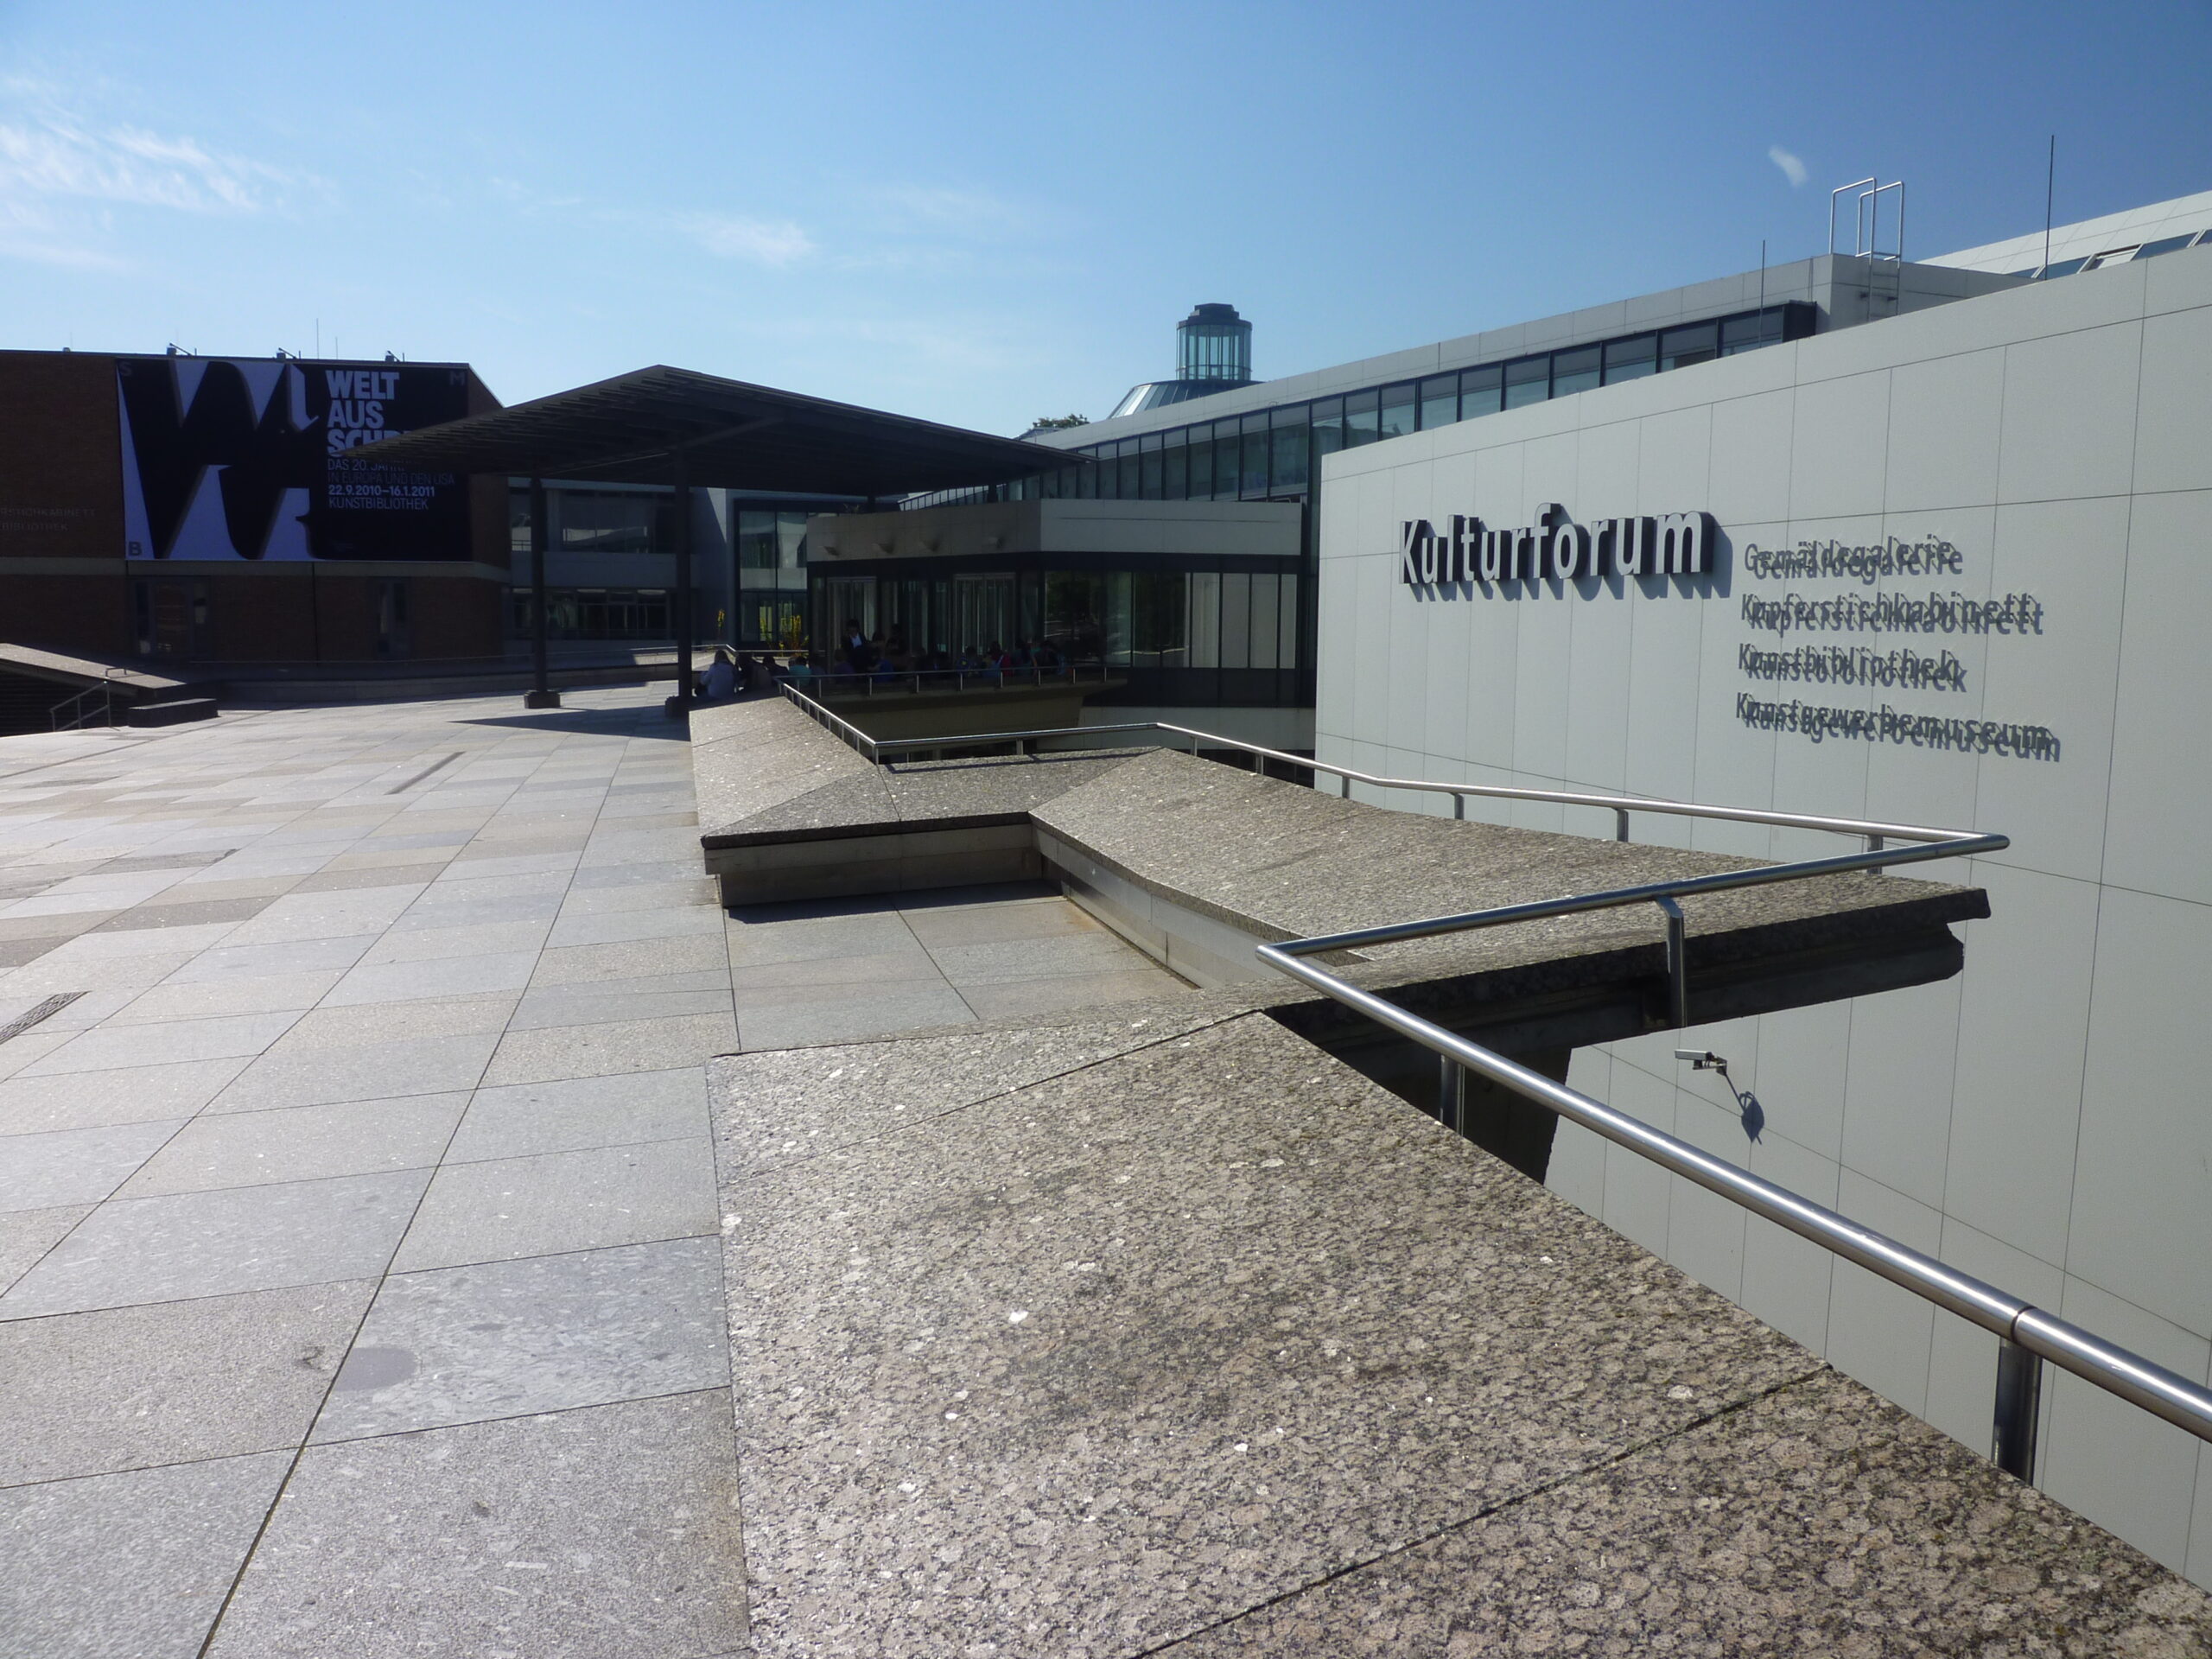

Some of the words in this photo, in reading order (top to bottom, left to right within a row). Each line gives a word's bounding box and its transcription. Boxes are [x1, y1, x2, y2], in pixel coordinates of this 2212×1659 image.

[325, 370, 400, 400] WELT
[327, 400, 385, 429] AUS
[327, 459, 349, 471] DAS
[328, 497, 429, 511] KUNSTBIBLIOTHEK
[128, 541, 143, 556] B
[1398, 502, 1714, 585] Kulturforum
[1744, 534, 1956, 579] Gemäldegalerie
[1741, 592, 2036, 631] Kupferstichkabinett
[1738, 643, 1960, 684] Kunstbibliothek
[1736, 692, 2052, 753] Kunstgewerbemuseum
